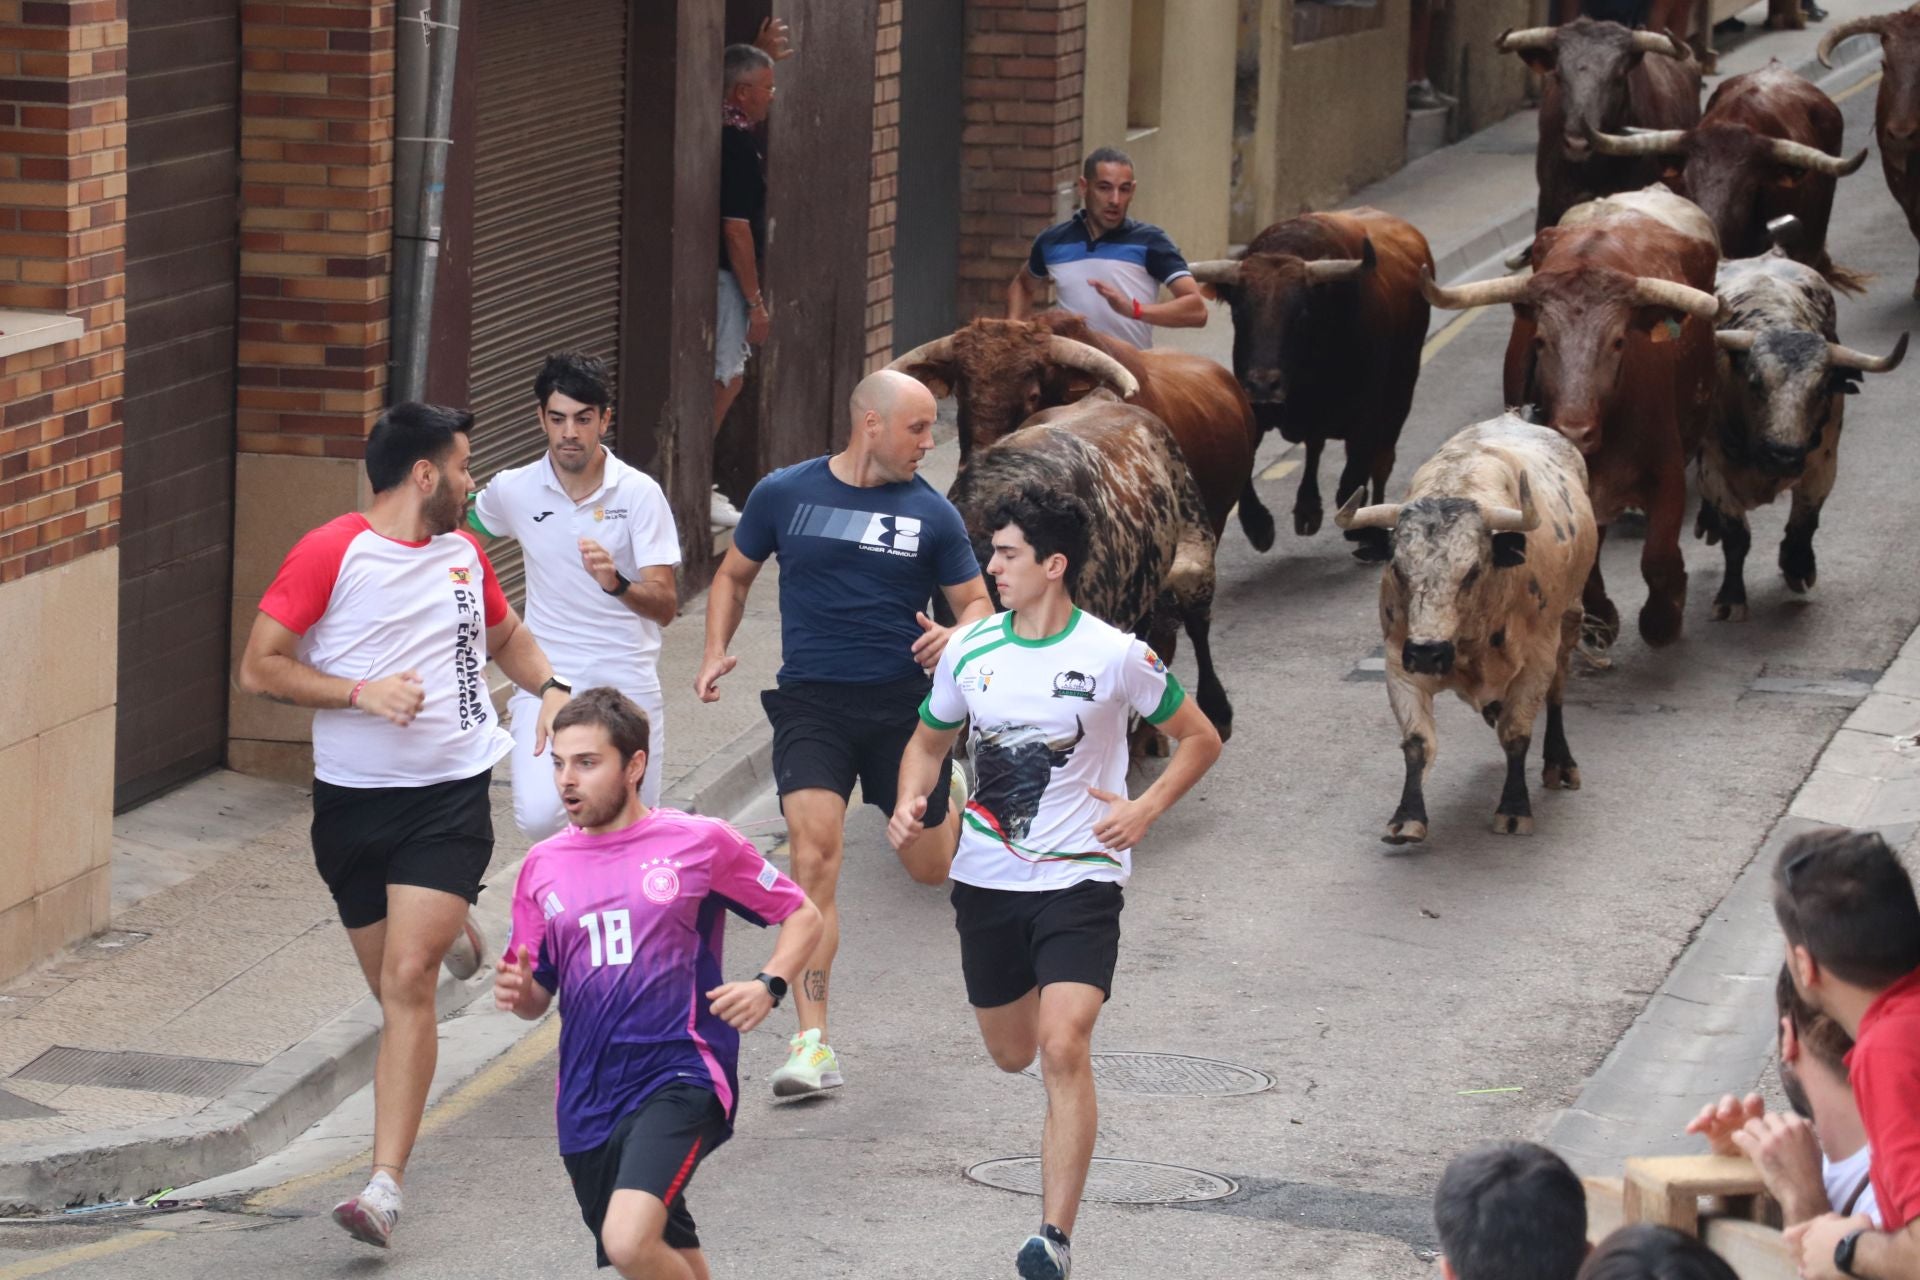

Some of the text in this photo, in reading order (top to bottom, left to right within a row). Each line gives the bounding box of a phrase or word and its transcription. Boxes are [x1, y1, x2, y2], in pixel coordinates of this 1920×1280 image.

[859, 544, 918, 558] UNDER ARMOUR
[454, 589, 473, 730] DE ENCIERROS
[578, 909, 633, 967] 18
